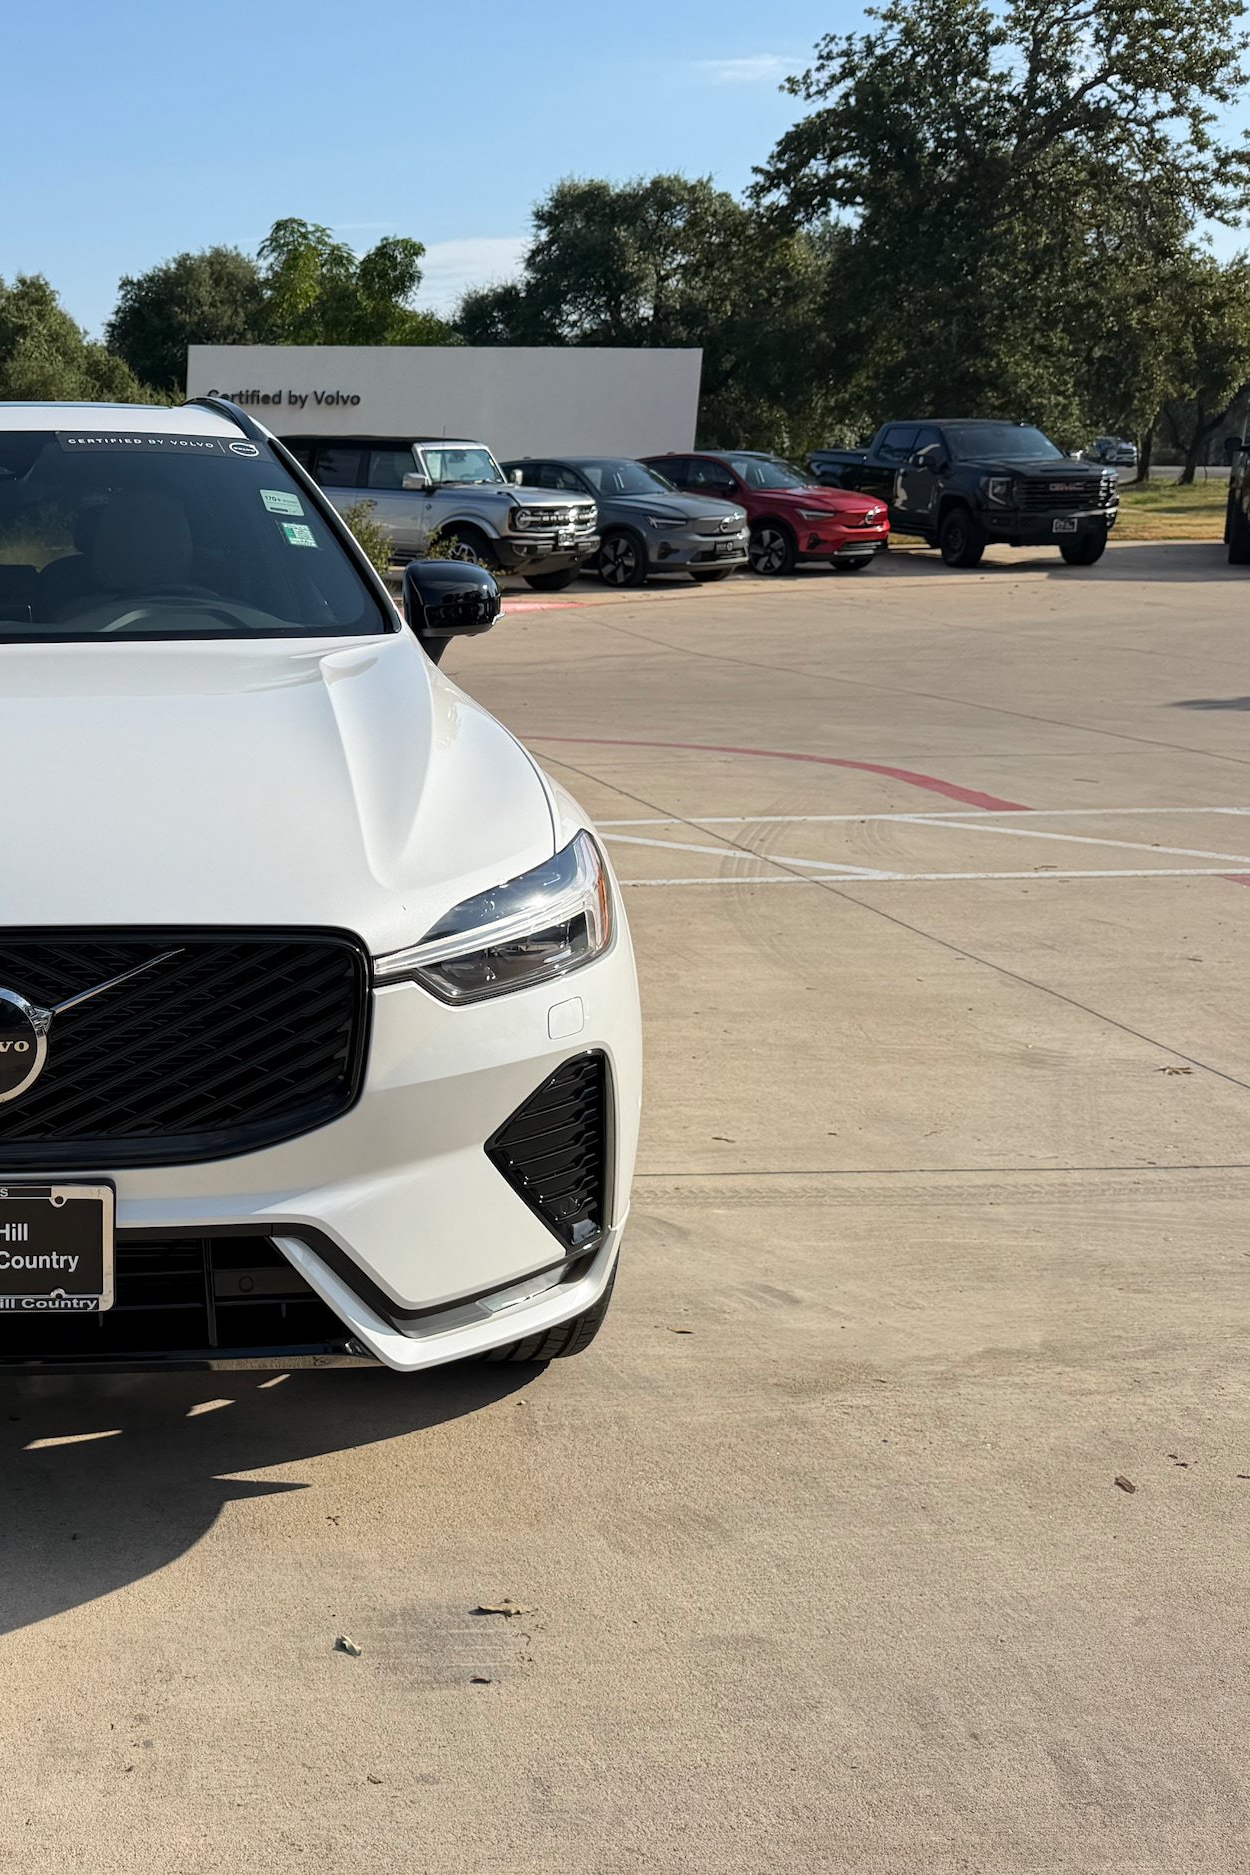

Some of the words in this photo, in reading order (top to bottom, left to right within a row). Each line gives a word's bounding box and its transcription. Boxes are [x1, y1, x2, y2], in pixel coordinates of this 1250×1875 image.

[288, 390, 308, 409] by
[313, 390, 361, 406] Volvo
[170, 440, 214, 448] VOLVO
[21, 1298, 98, 1311] Country
